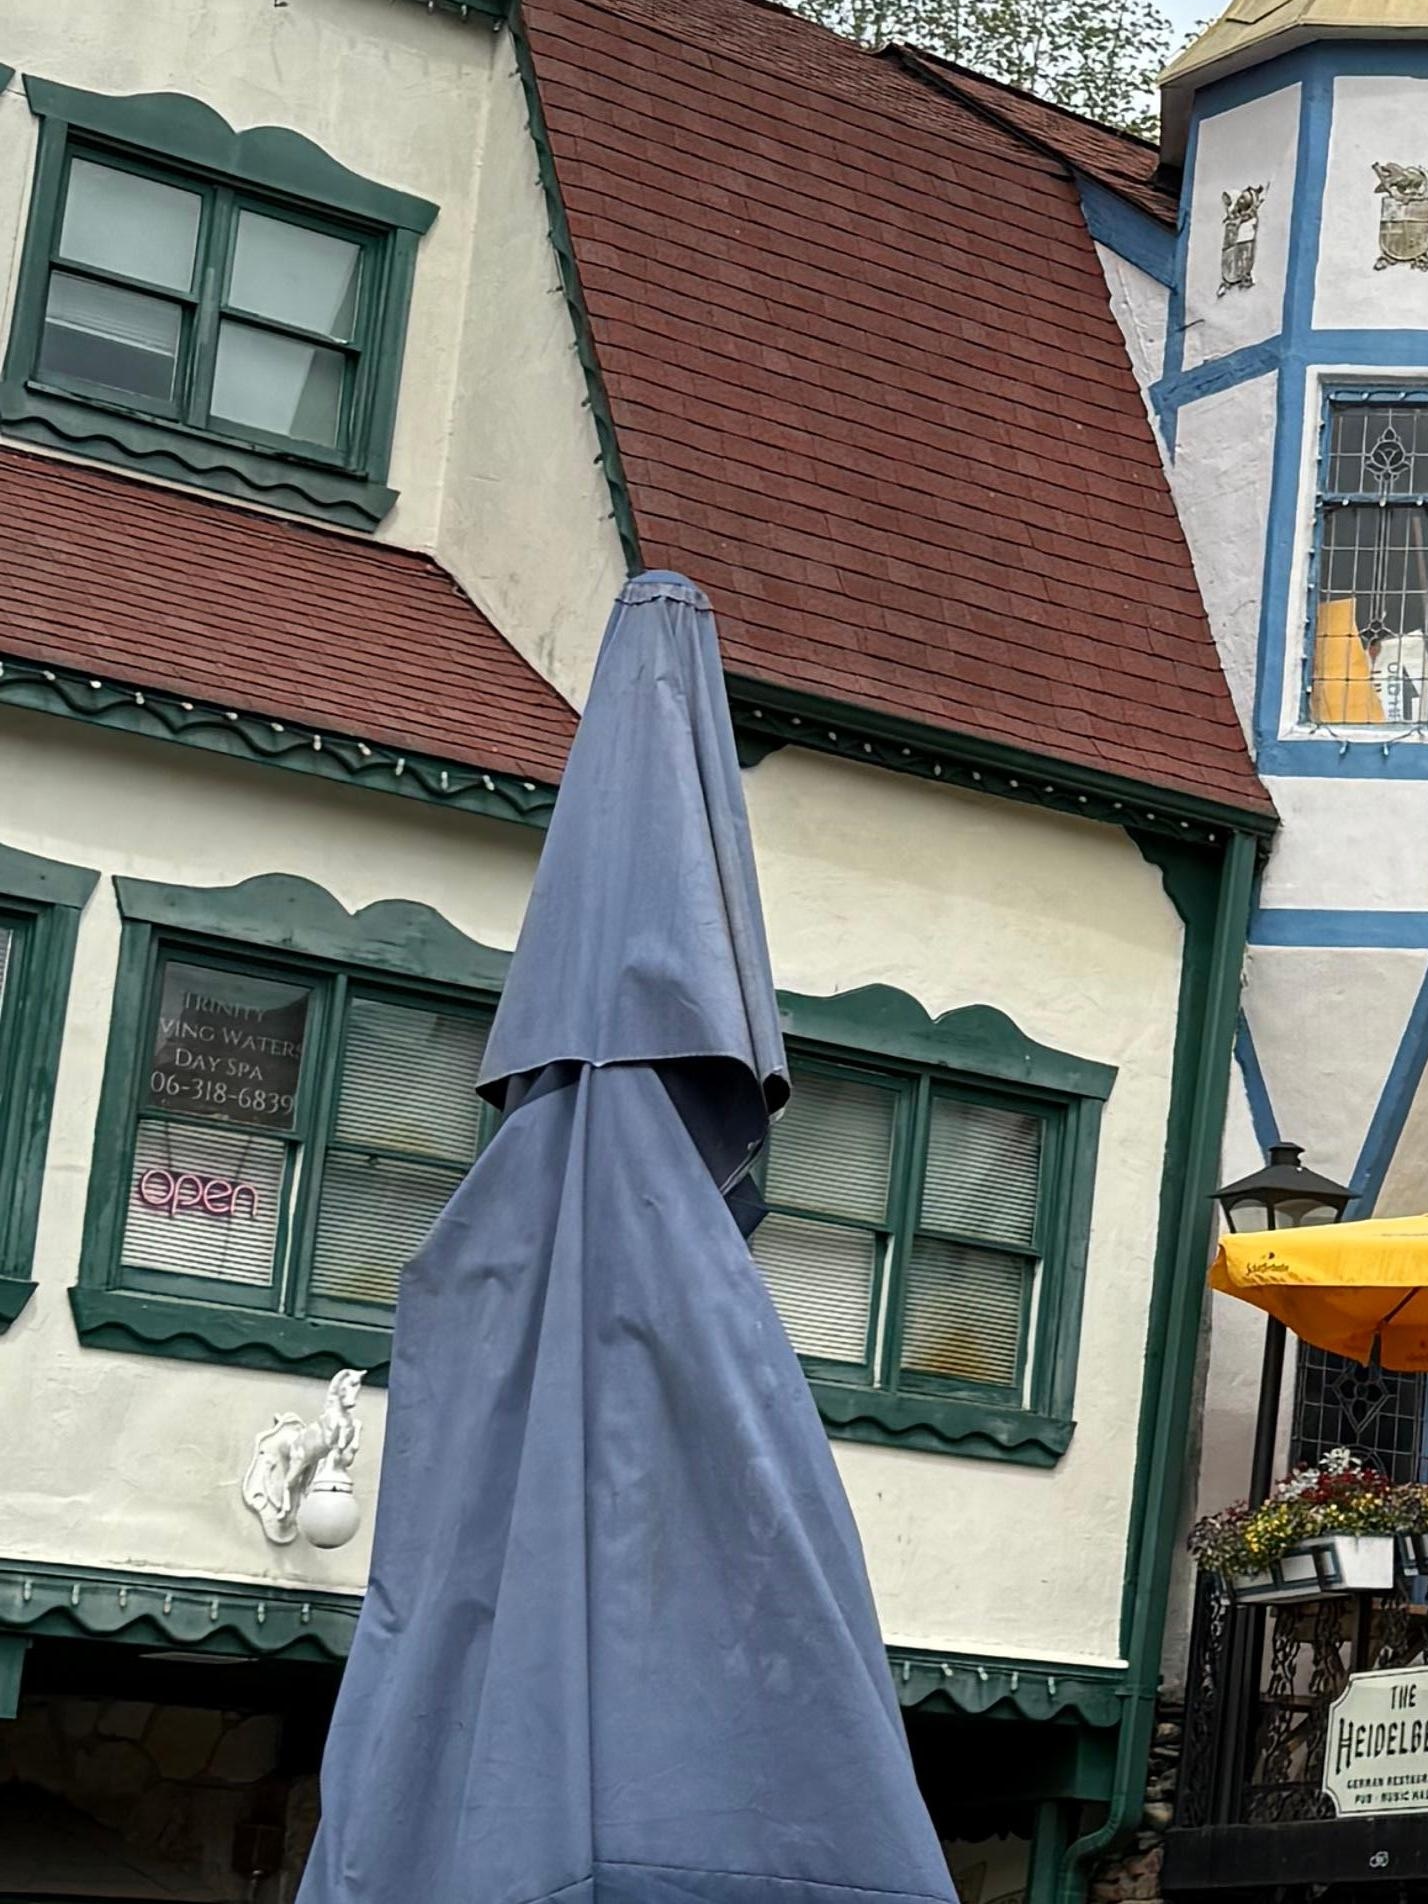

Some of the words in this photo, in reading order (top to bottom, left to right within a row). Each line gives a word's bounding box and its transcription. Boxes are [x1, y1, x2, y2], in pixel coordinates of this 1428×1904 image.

[186, 992, 265, 1022] TRINITY
[175, 1048, 221, 1072] DAY
[226, 1058, 263, 1081] SPA
[151, 1070, 294, 1114] 06-318-6839
[141, 1169, 258, 1216] open
[1391, 1684, 1416, 1710] THE
[1347, 1776, 1384, 1789] GERMAN
[1355, 1793, 1372, 1804] PUB
[1381, 1791, 1409, 1803] MUSIC
